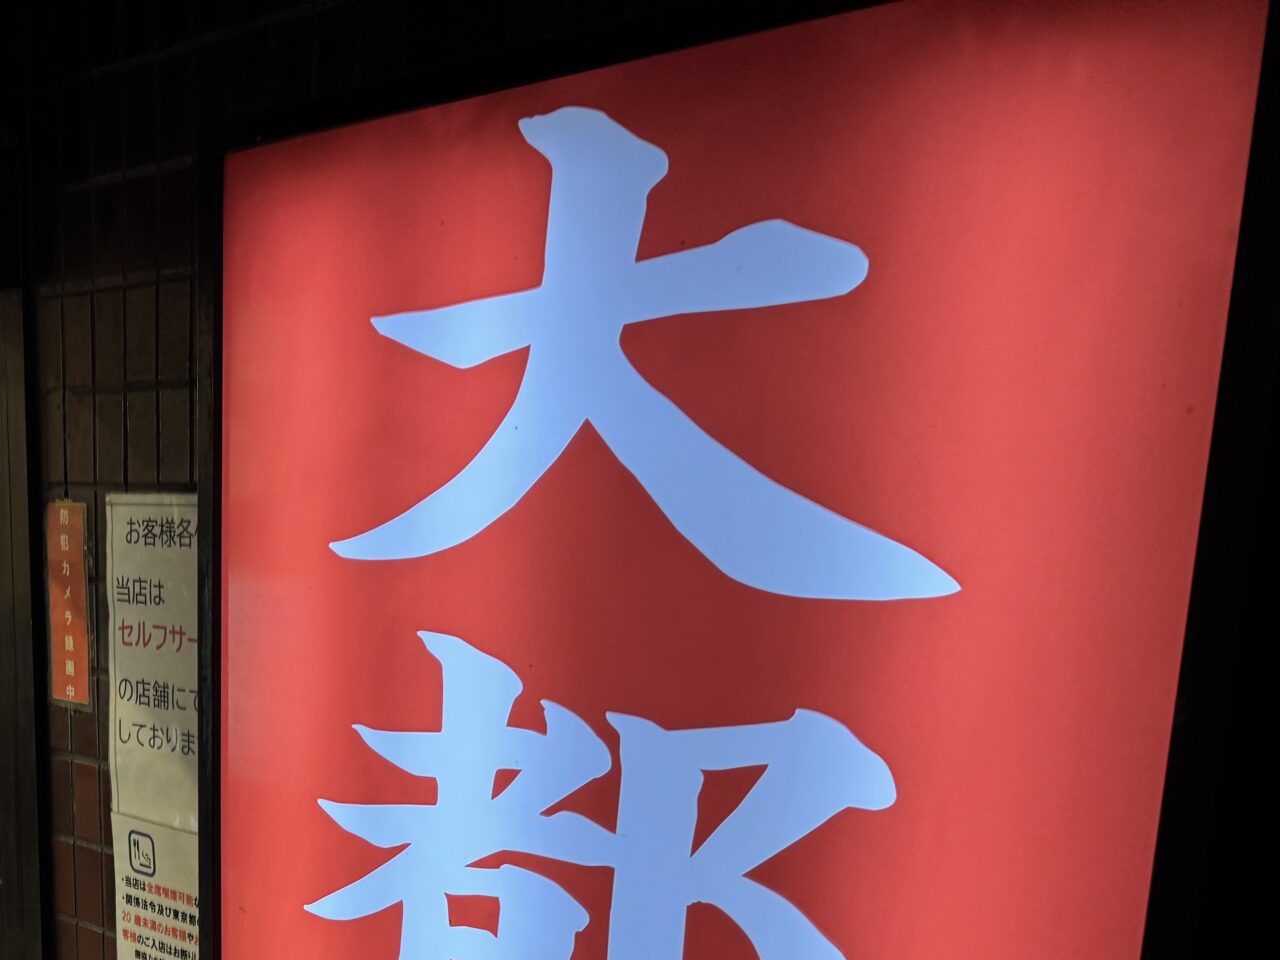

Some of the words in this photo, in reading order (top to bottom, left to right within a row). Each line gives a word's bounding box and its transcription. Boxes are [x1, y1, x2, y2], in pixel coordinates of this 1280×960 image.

[124, 515, 198, 550] お客様各
[59, 507, 76, 700] 防犯カメラ録画中
[114, 575, 166, 608] 当店は
